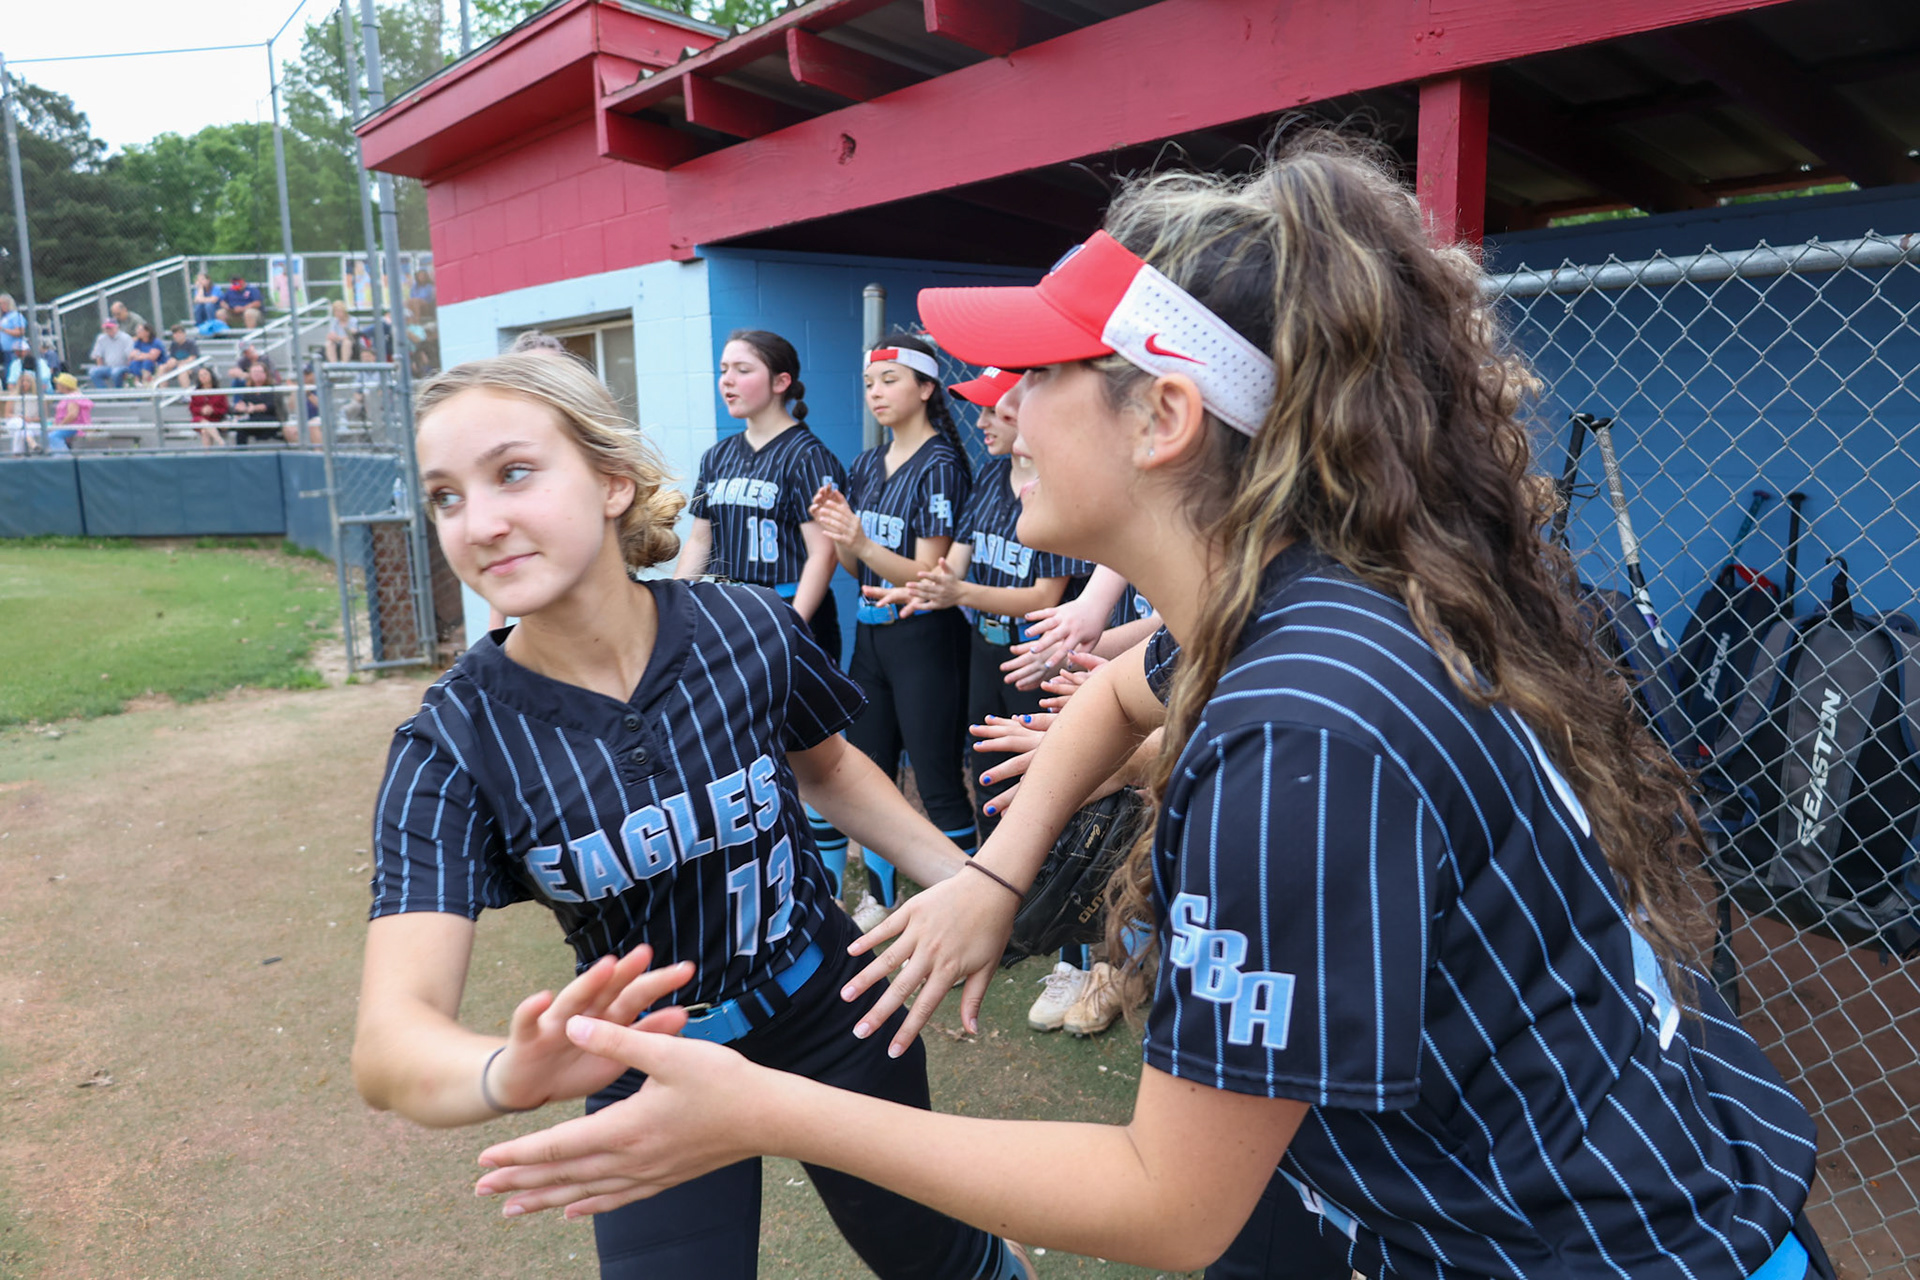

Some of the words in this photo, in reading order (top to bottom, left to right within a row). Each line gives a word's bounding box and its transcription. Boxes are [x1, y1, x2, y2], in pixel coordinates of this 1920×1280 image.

[747, 516, 779, 563] 18
[856, 509, 905, 549] GLES
[1802, 687, 1842, 821] EASTON
[523, 753, 782, 903] EAGLES
[727, 833, 795, 957] 13
[1169, 892, 1296, 1050] SBA
